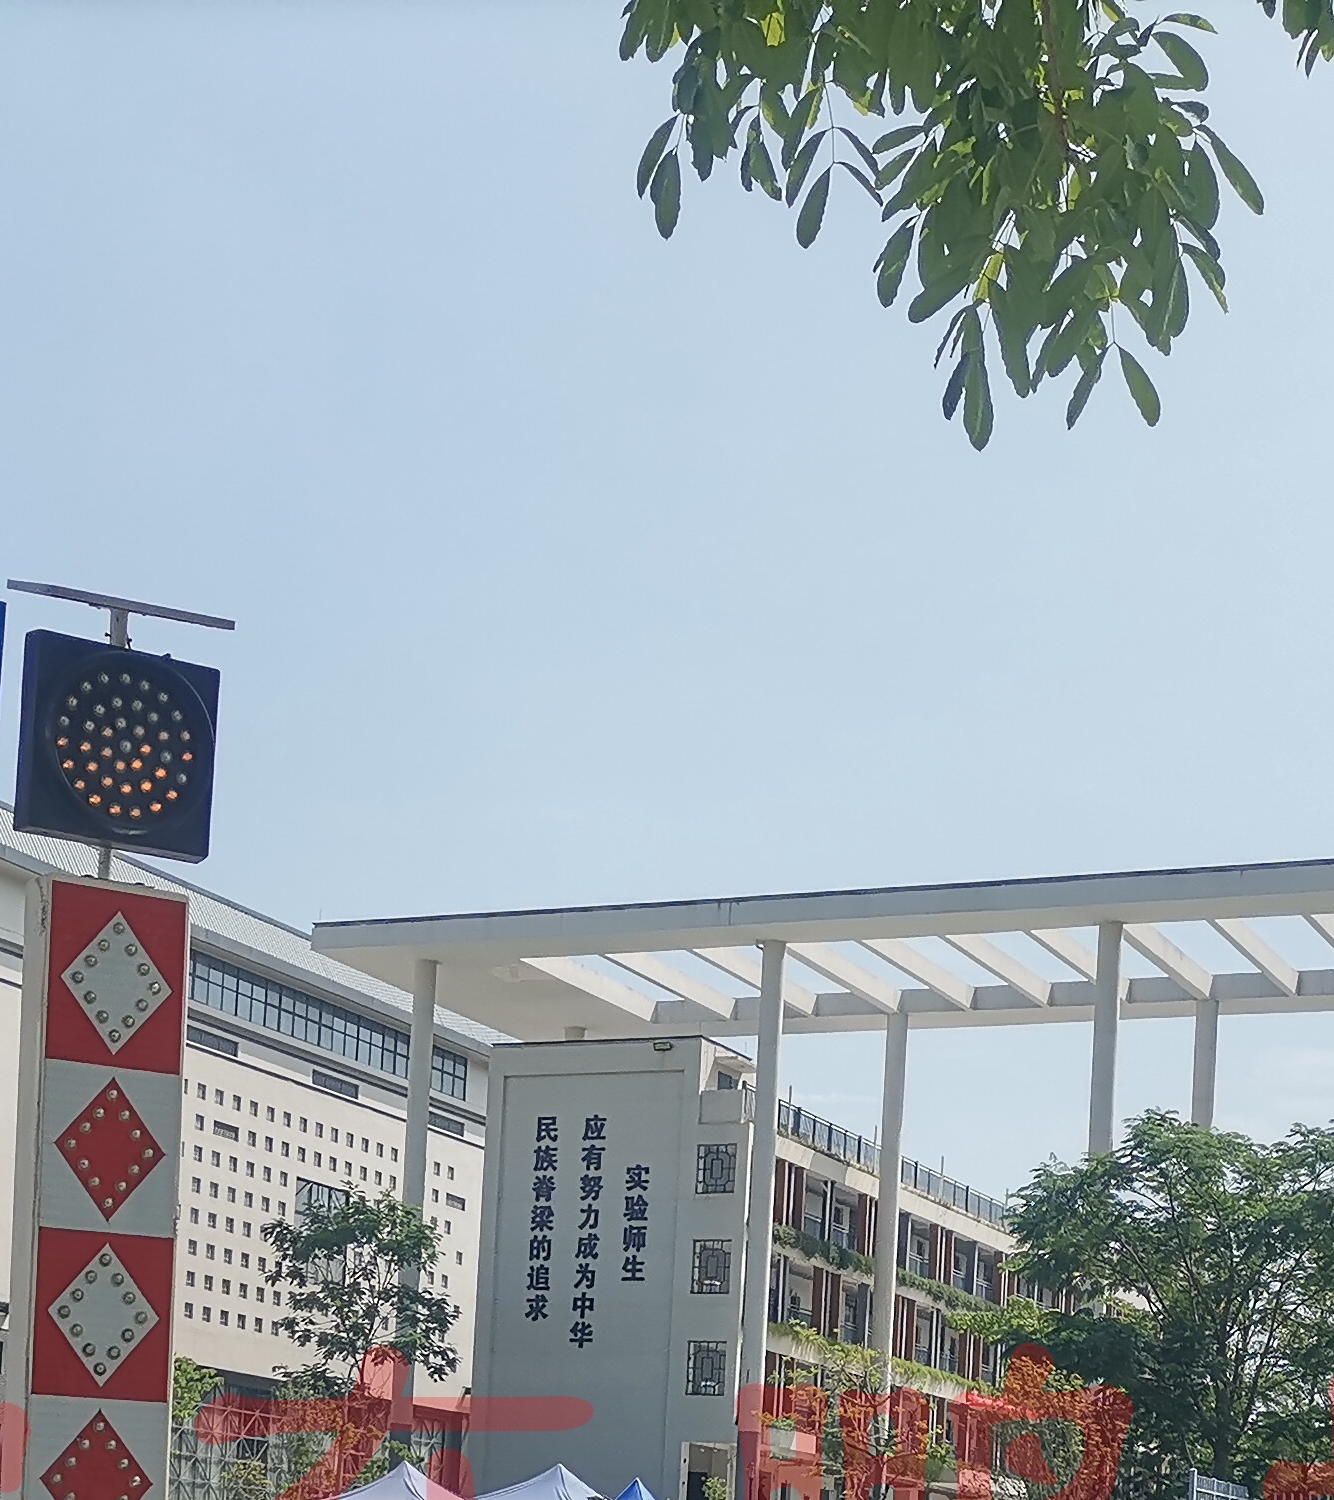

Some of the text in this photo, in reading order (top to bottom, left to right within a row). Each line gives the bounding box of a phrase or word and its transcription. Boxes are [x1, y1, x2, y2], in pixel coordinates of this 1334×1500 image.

[524, 1115, 559, 1322] 民族脊梁的追求
[568, 1113, 608, 1349] 应有努力成为中华
[621, 1164, 651, 1283] 实验师生
